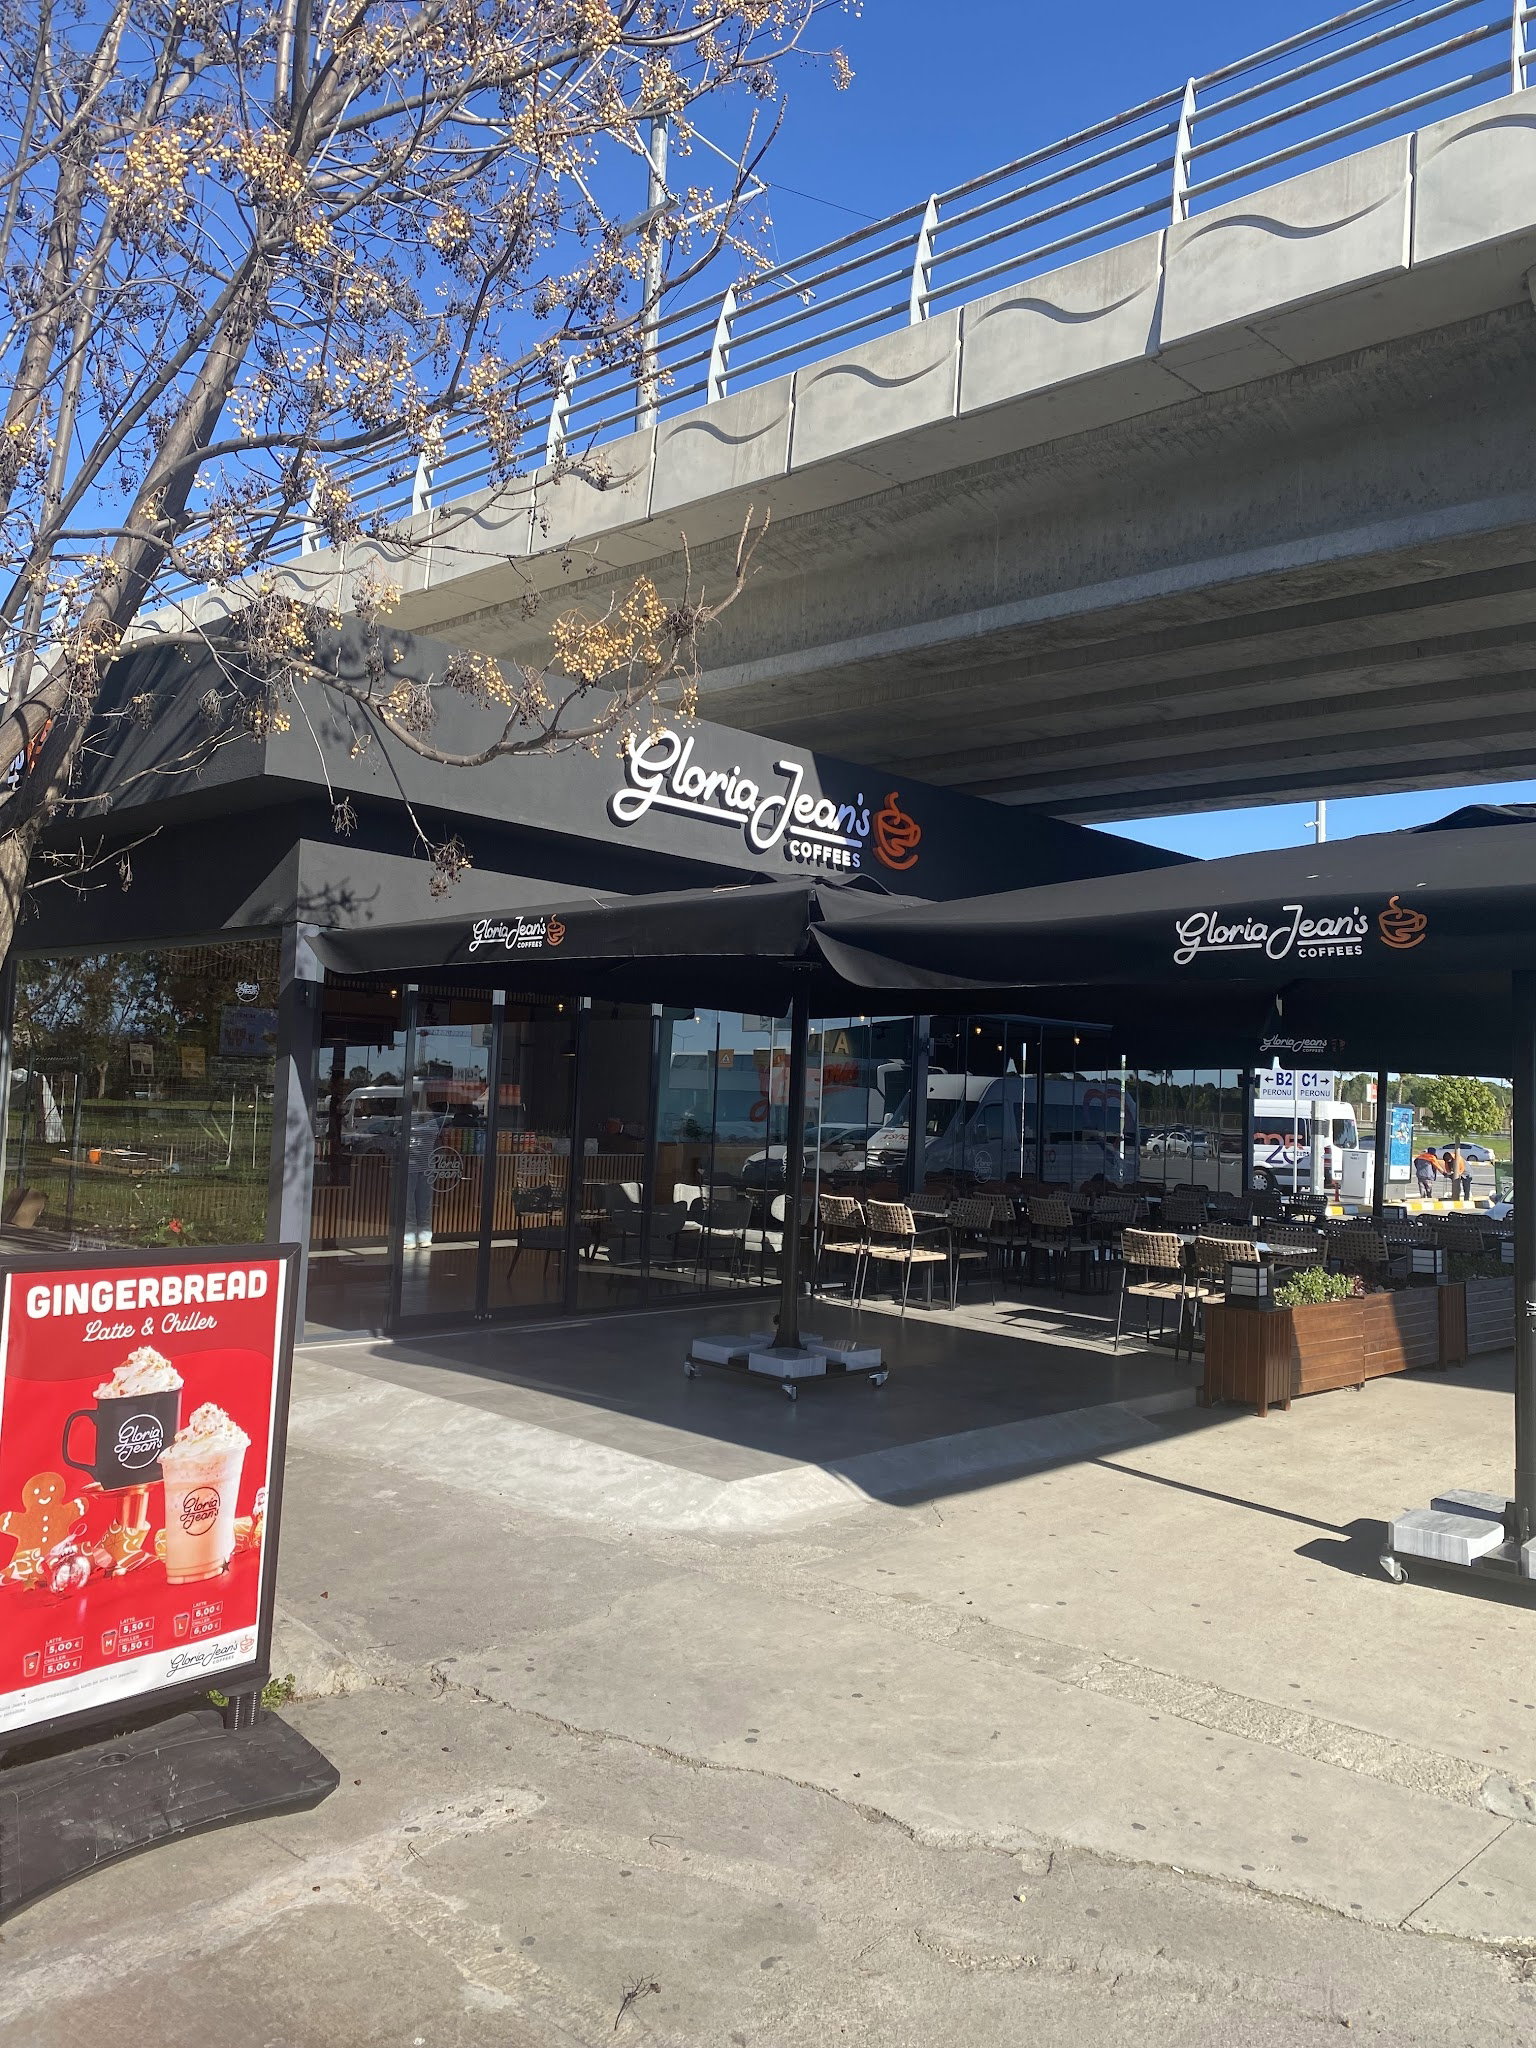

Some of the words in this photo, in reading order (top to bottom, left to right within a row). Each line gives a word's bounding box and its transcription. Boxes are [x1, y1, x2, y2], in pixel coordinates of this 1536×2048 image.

[612, 729, 760, 822] Gloria
[750, 760, 871, 849] Jean's
[790, 839, 861, 868] COFFEES
[468, 918, 509, 952] Gloria
[505, 916, 547, 949] Jean's
[1173, 911, 1268, 965] Gloria
[1266, 904, 1369, 960] Jean's
[517, 940, 542, 949] COFFEES
[1298, 945, 1363, 958] COFFEES
[1276, 1072, 1292, 1086] B2
[1302, 1073, 1317, 1087] C1
[1262, 1088, 1292, 1096] PERONU
[1300, 1089, 1331, 1097] PERONU
[26, 1269, 268, 1319] GINGERBREAD
[82, 1318, 136, 1342] Latte
[141, 1318, 154, 1336] &
[161, 1312, 218, 1334] Chiller
[114, 1425, 160, 1453] Gloria
[118, 1438, 162, 1462] Jean's
[180, 1496, 218, 1521] Gloria
[119, 1617, 136, 1625] LATTE
[122, 1621, 144, 1634] 5,50
[45, 1637, 62, 1645] LATTE
[48, 1642, 73, 1654] 5,00
[121, 1641, 143, 1653] 5,50
[28, 1662, 35, 1670] S
[166, 1652, 205, 1678] Gloria
[201, 1641, 239, 1667] Jean's
[47, 1661, 71, 1674] 5,00
